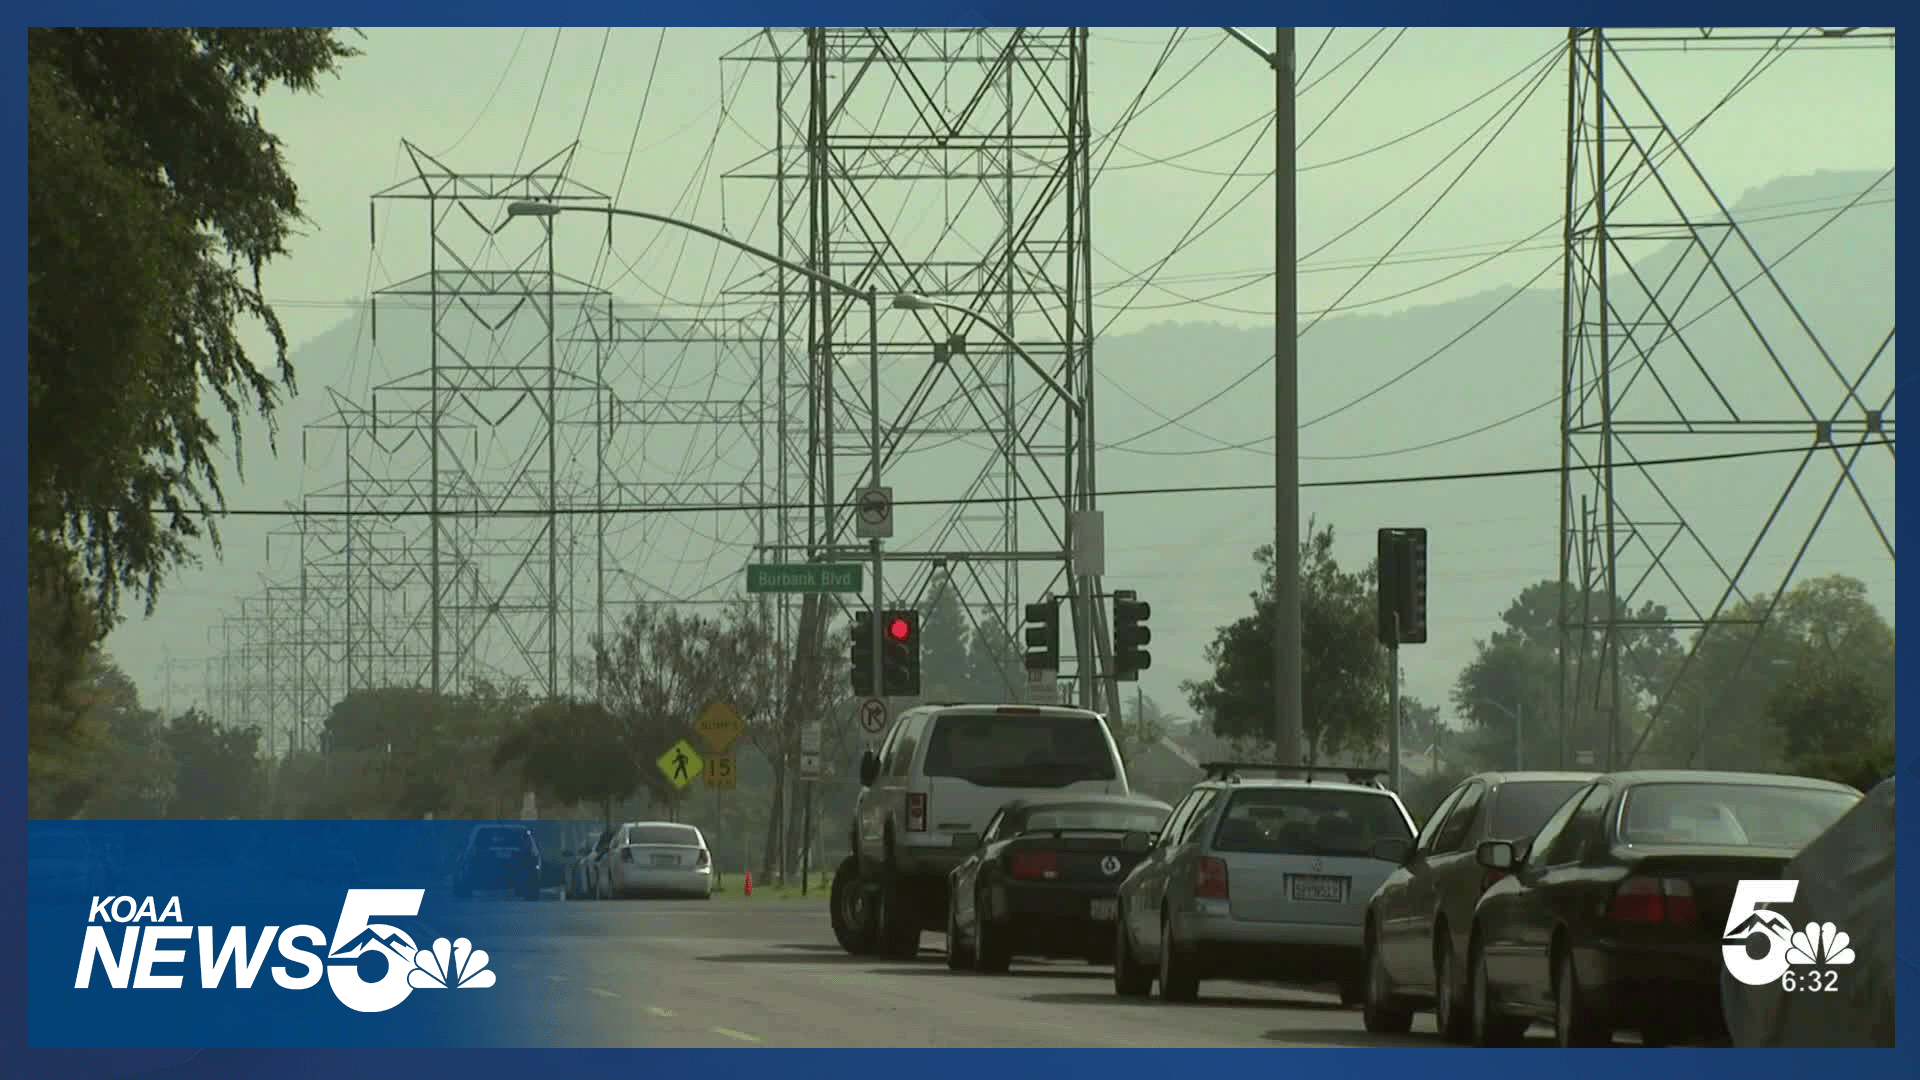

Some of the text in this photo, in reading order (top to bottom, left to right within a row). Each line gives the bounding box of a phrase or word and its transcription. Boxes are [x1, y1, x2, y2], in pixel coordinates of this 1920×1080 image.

[759, 571, 851, 586] Burbank Blvd
[710, 758, 731, 776] 15
